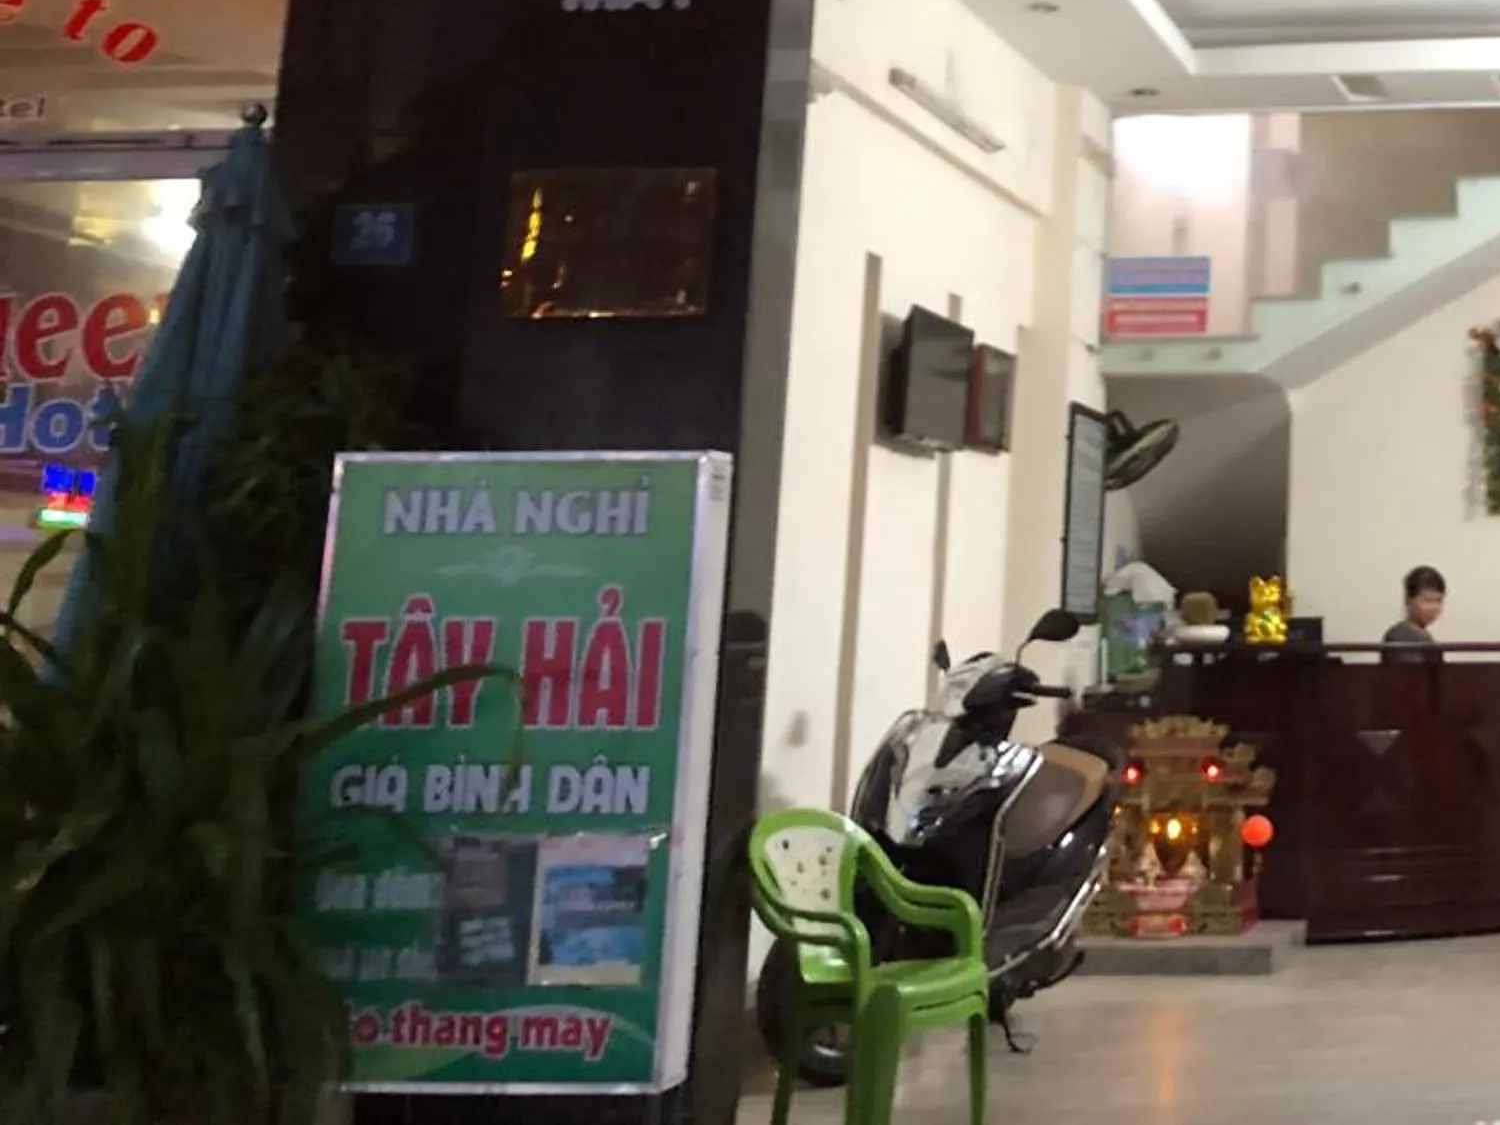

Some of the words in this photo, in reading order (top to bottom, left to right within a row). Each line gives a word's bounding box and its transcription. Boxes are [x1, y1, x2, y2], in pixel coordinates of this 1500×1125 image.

[350, 210, 397, 249] 26
[515, 476, 650, 534] NGHỈ
[340, 593, 497, 729] TÂY
[521, 584, 666, 729] HẢI
[546, 753, 650, 814] DÂN
[391, 1000, 507, 1058] thang
